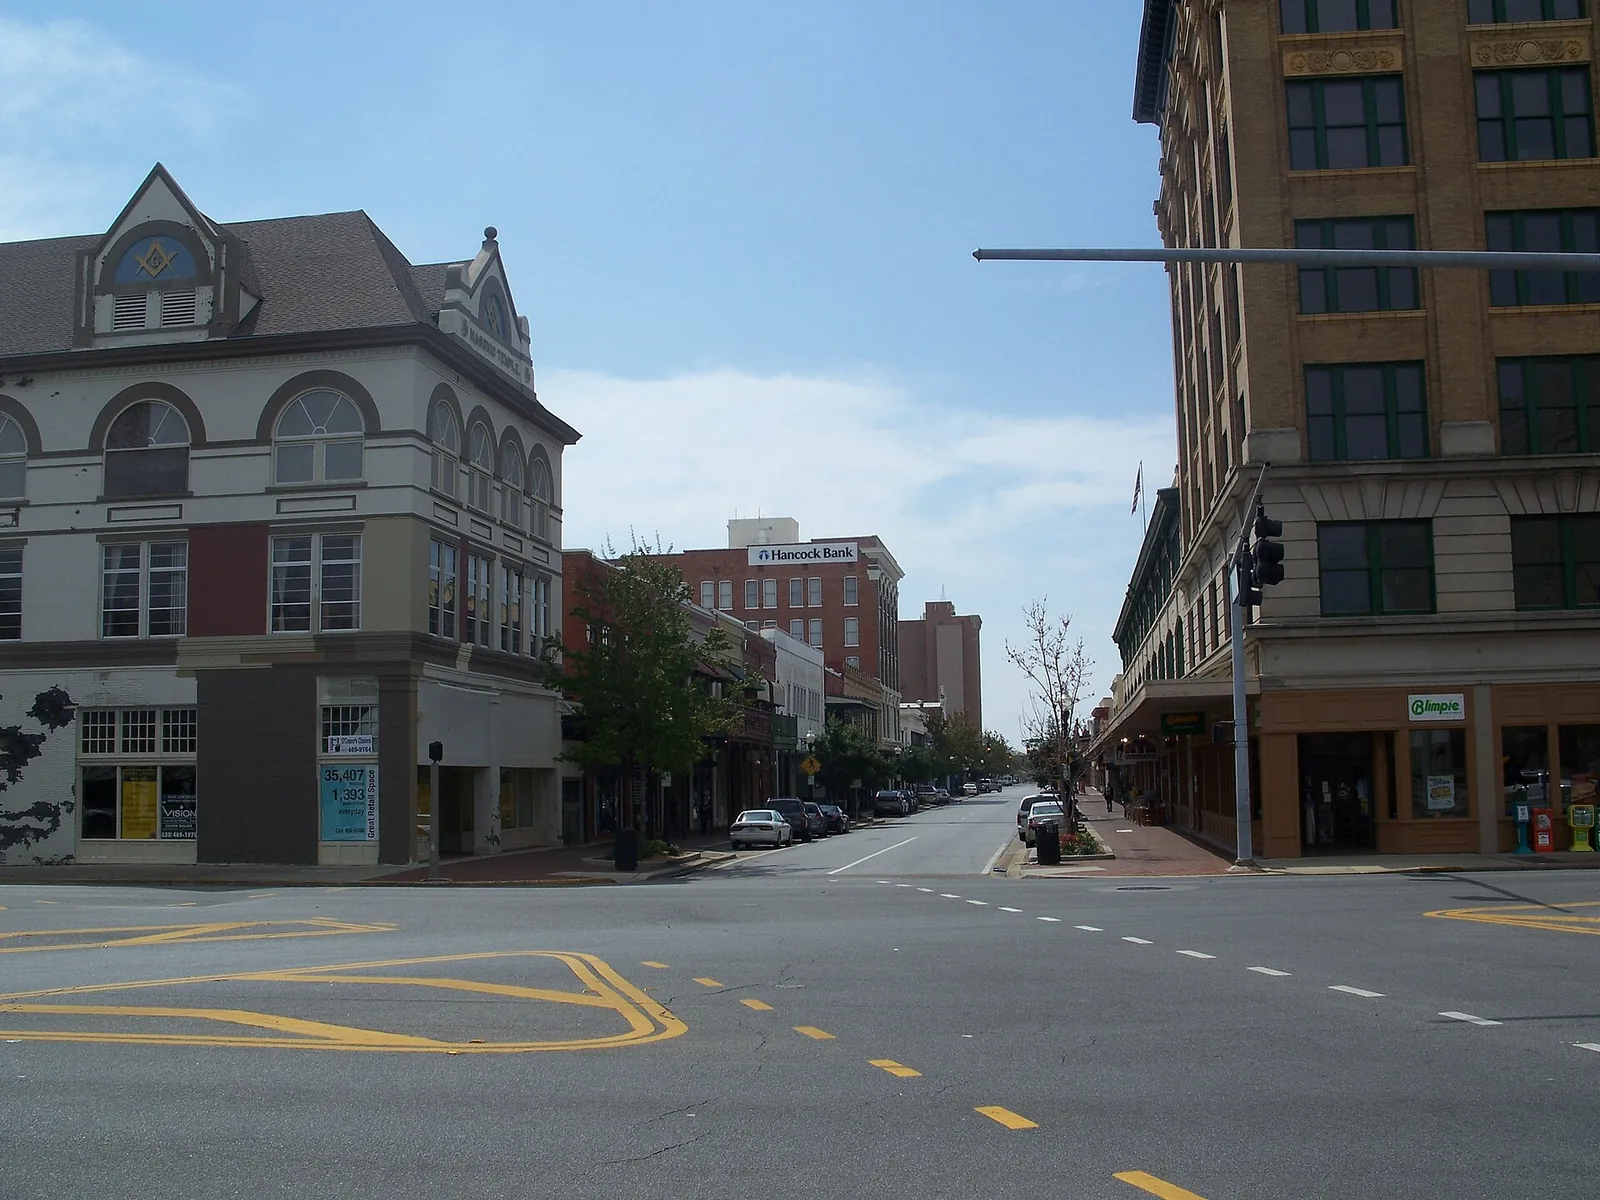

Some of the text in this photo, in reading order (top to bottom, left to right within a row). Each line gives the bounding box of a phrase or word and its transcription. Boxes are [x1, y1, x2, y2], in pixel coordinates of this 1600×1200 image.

[771, 547, 853, 560] Hancock Bank
[1411, 699, 1460, 715] Blimpie
[324, 769, 365, 783] 35,407
[367, 769, 376, 793] Space
[332, 788, 365, 803] 1,393
[161, 804, 197, 817] VISION
[338, 808, 365, 816] everyday
